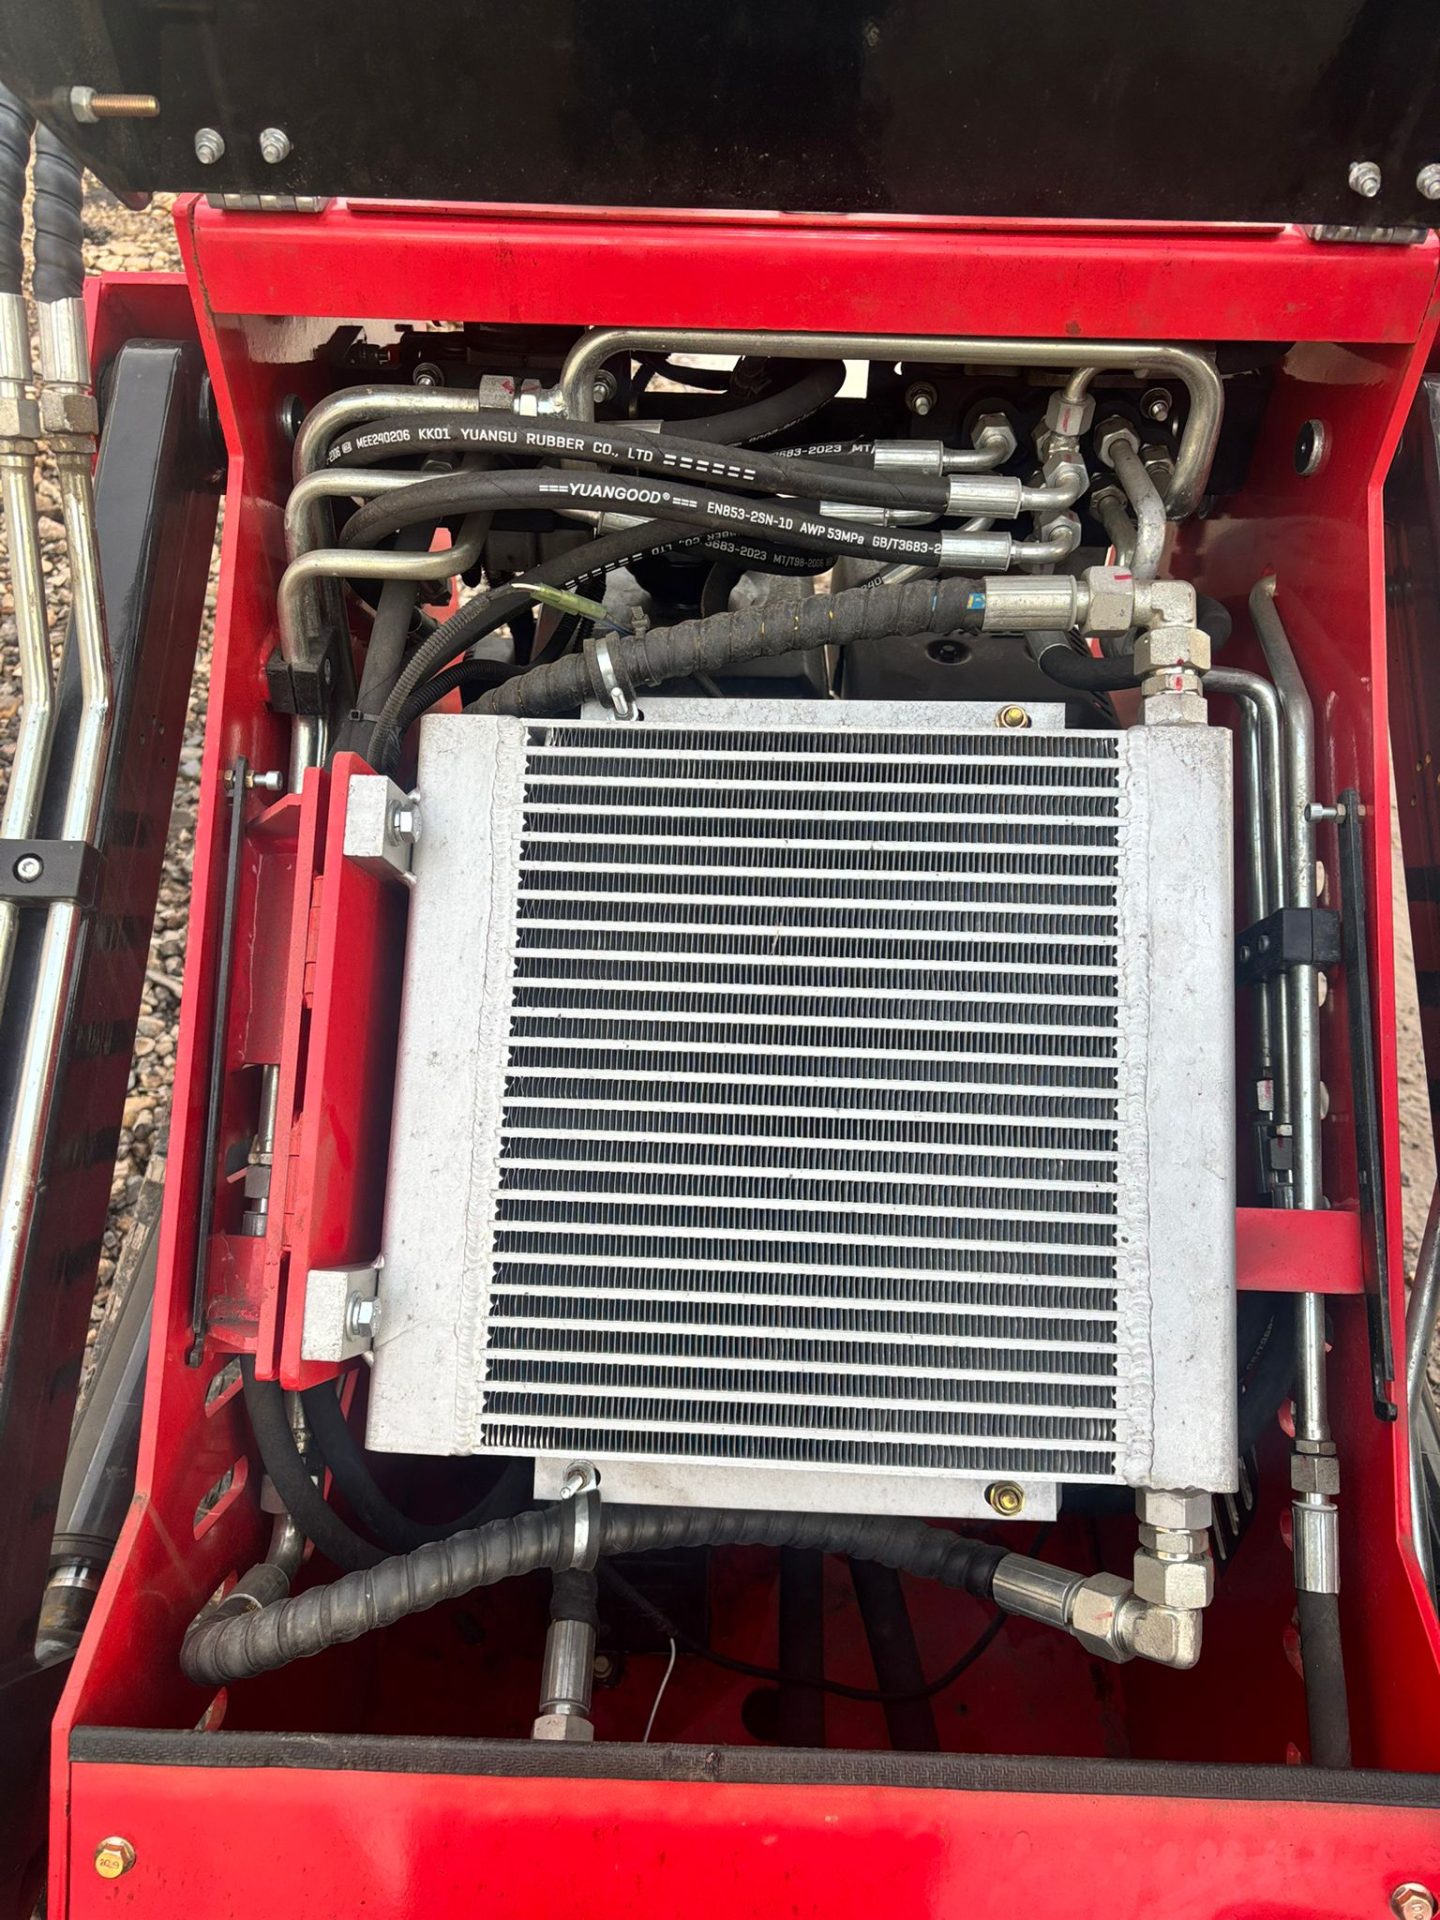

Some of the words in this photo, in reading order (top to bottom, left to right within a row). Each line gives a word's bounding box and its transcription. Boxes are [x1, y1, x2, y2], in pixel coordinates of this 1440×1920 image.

[355, 429, 411, 449] MEE240206
[418, 427, 451, 440] KK01
[461, 428, 518, 443] YUANGU
[526, 432, 585, 451] RUBBER
[593, 442, 619, 458] CO.,
[627, 447, 653, 462] LTD
[706, 501, 794, 530] EN853-2SN-10
[800, 522, 826, 537] AWP
[827, 527, 865, 545] 53MPa
